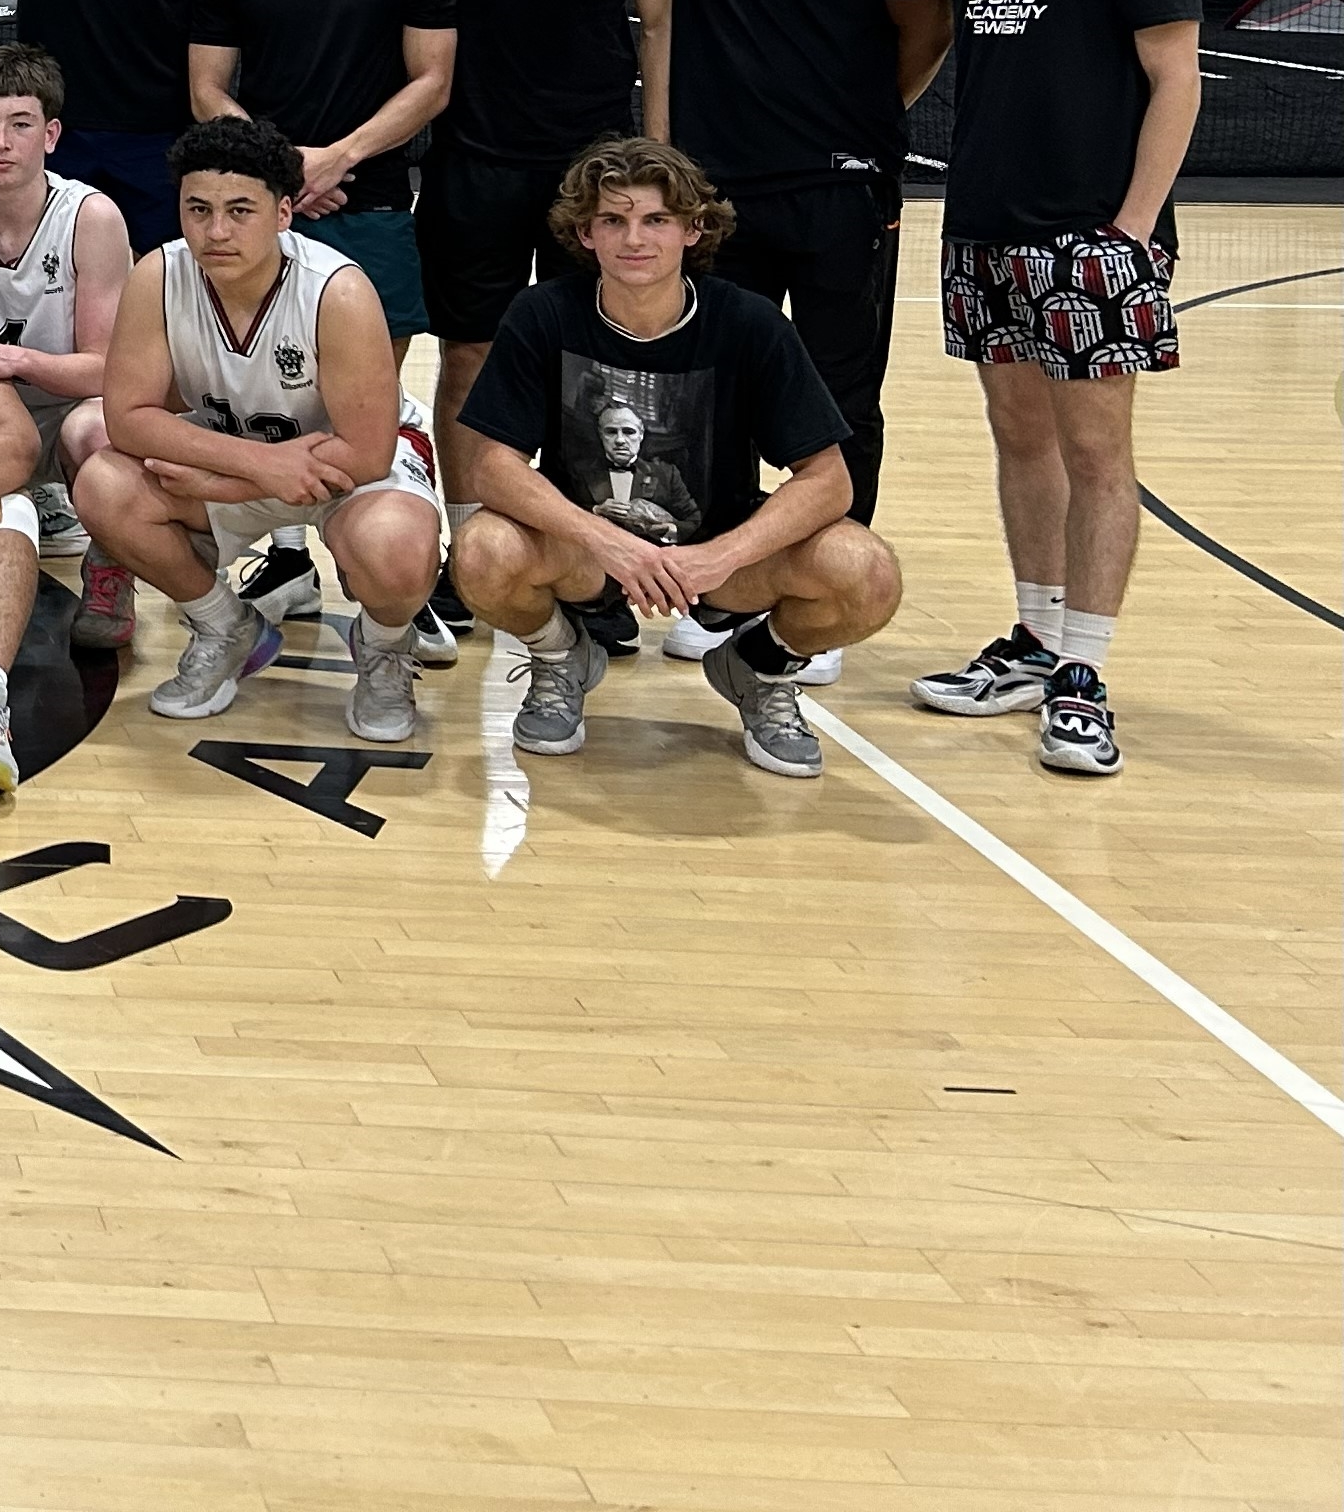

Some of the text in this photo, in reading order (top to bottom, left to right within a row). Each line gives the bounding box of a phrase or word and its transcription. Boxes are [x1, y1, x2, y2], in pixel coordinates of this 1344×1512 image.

[964, 4, 1048, 20] ACADEMY
[973, 20, 1027, 35] SWISH
[1071, 251, 1139, 300] SWEAT
[1041, 309, 1105, 355] SWEAT
